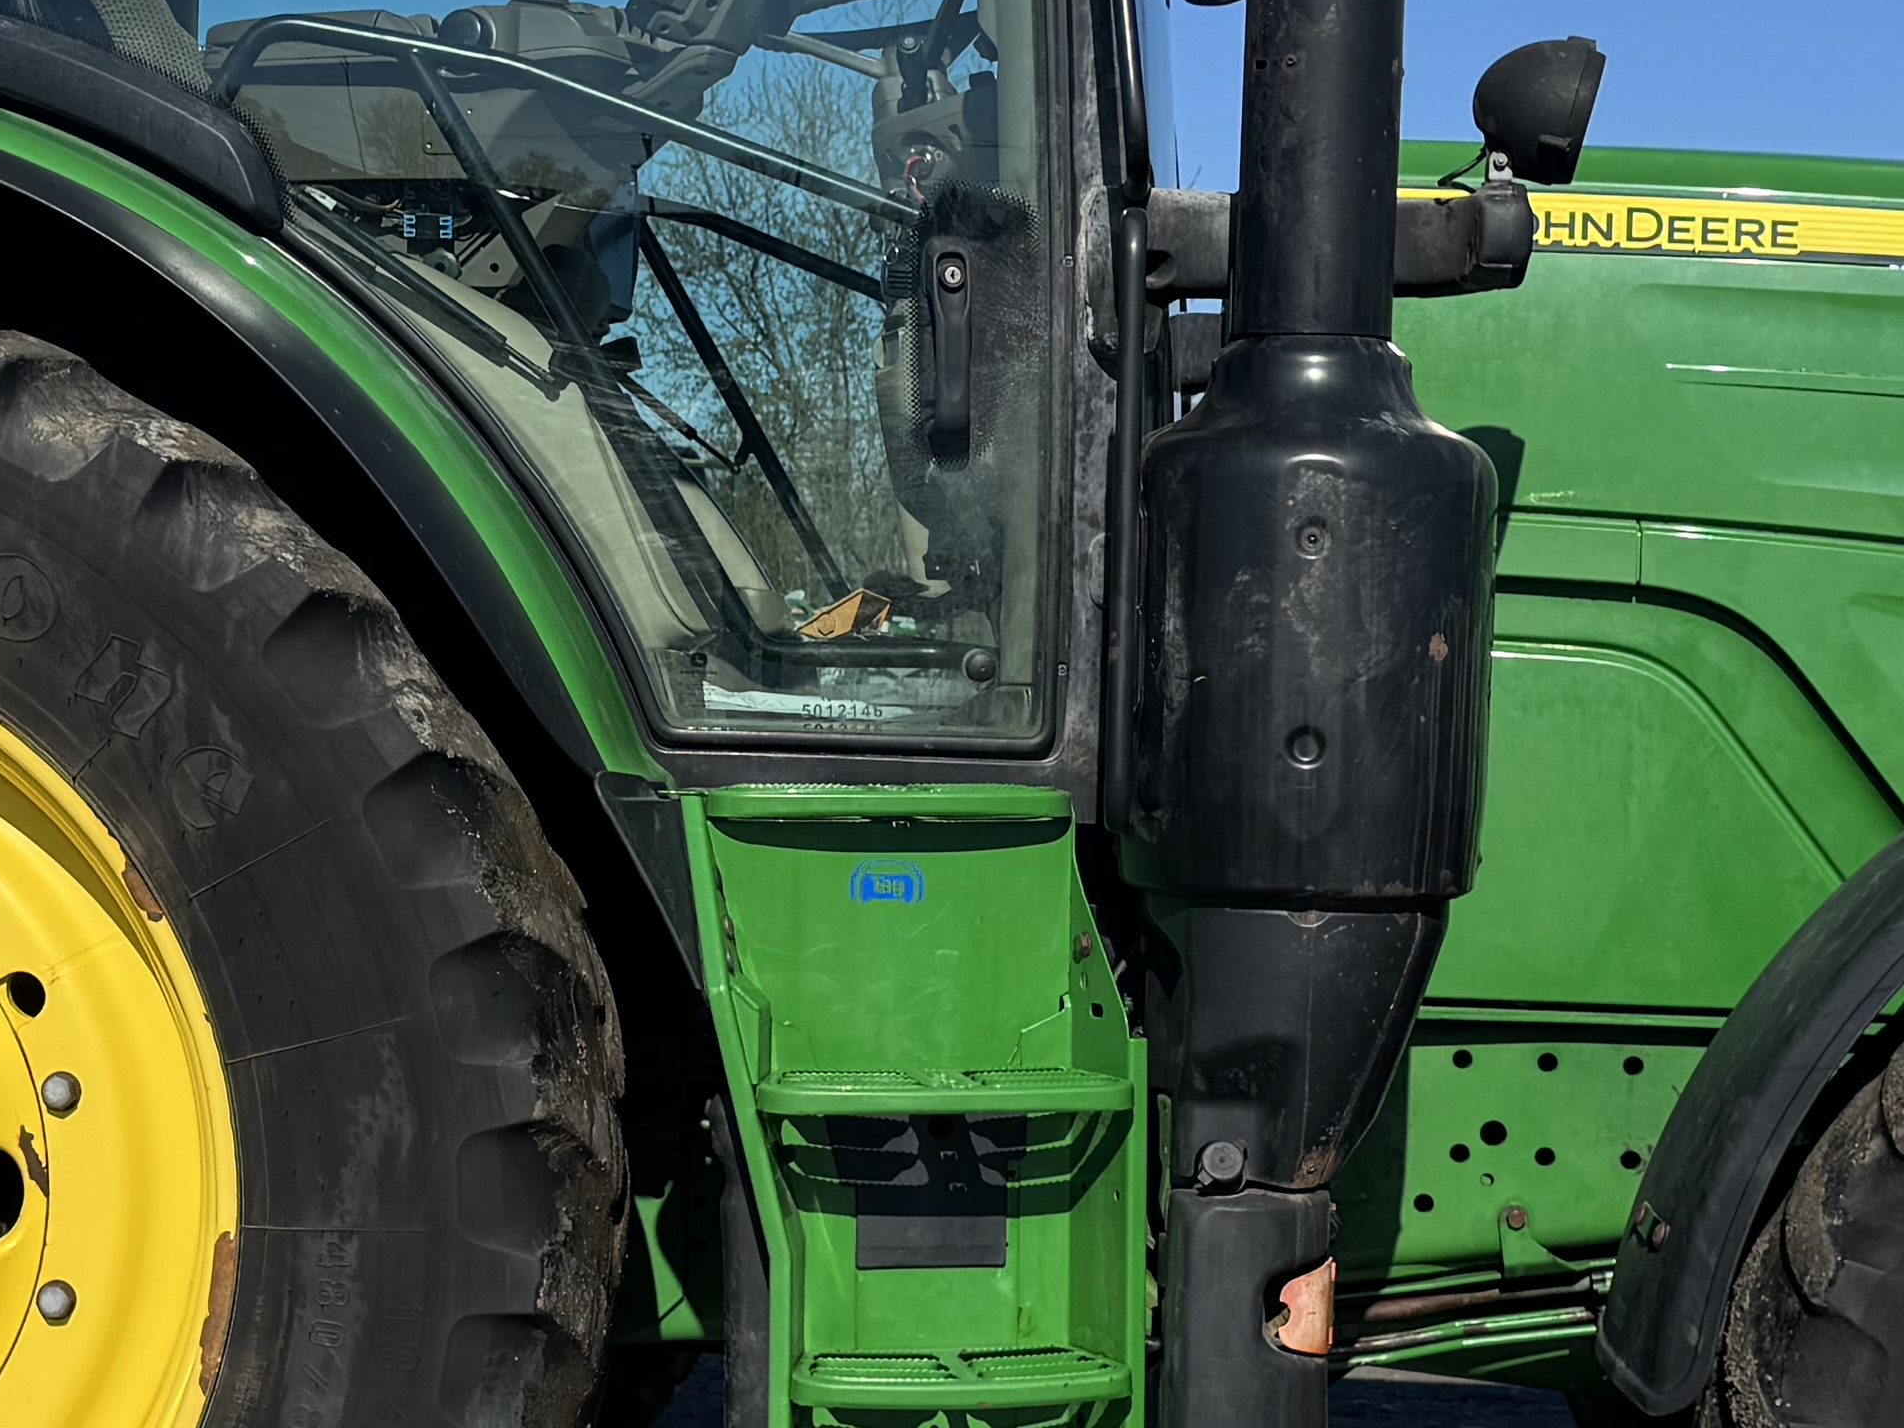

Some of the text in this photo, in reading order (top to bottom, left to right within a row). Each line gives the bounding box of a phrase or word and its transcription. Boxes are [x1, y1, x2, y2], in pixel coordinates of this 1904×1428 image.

[1533, 207, 1799, 248] HN DEERE
[801, 703, 883, 719] 5012146
